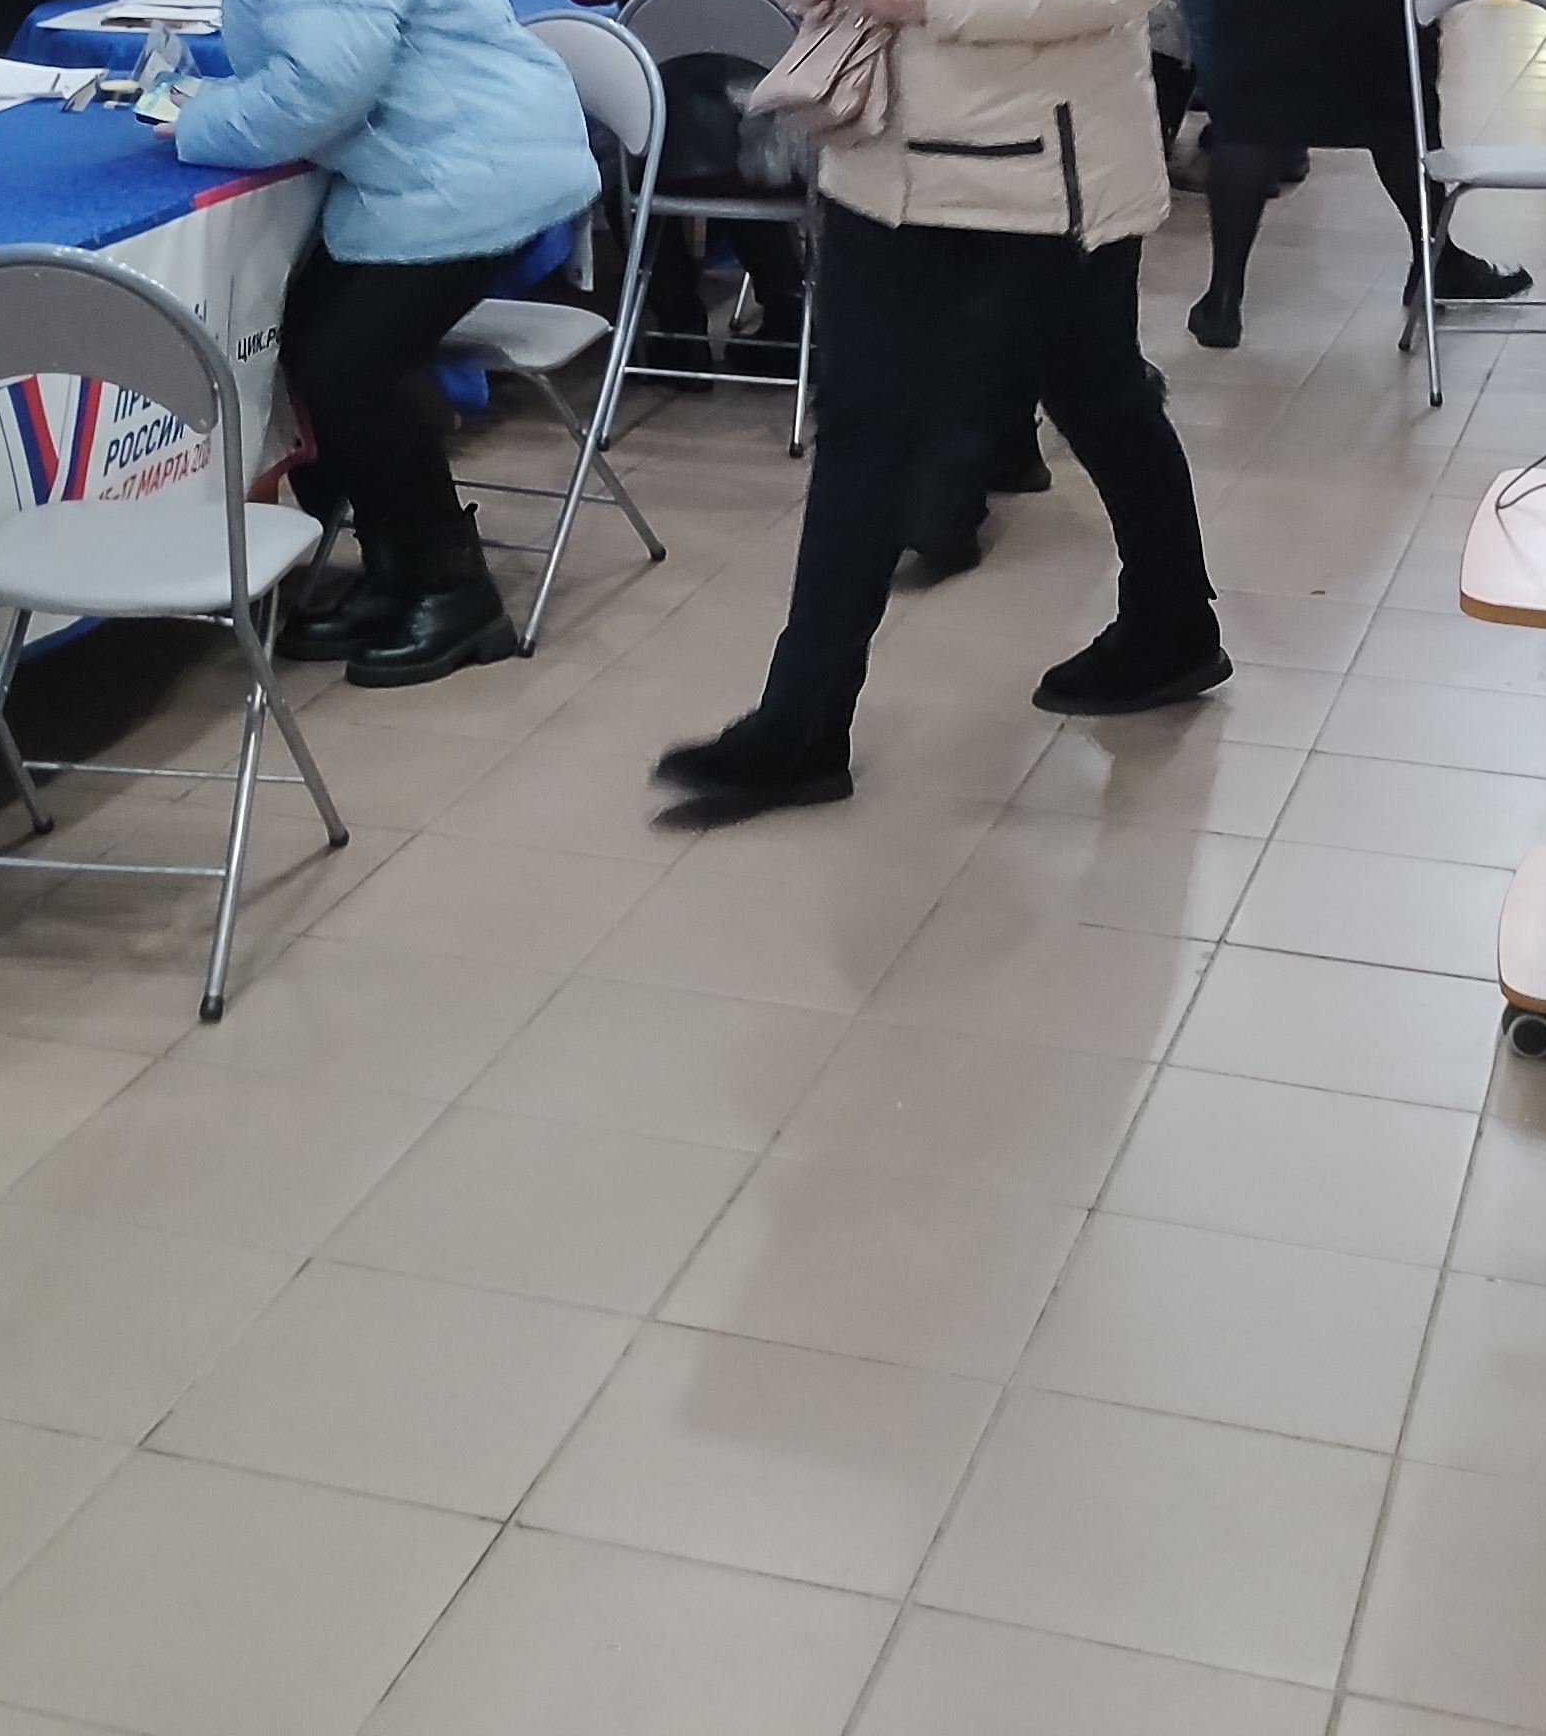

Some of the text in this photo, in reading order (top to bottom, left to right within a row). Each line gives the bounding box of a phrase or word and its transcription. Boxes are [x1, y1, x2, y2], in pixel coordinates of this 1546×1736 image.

[237, 326, 283, 363] ЦИК.Р
[104, 415, 185, 477] РОССИИ
[136, 450, 188, 501] МАРТА
